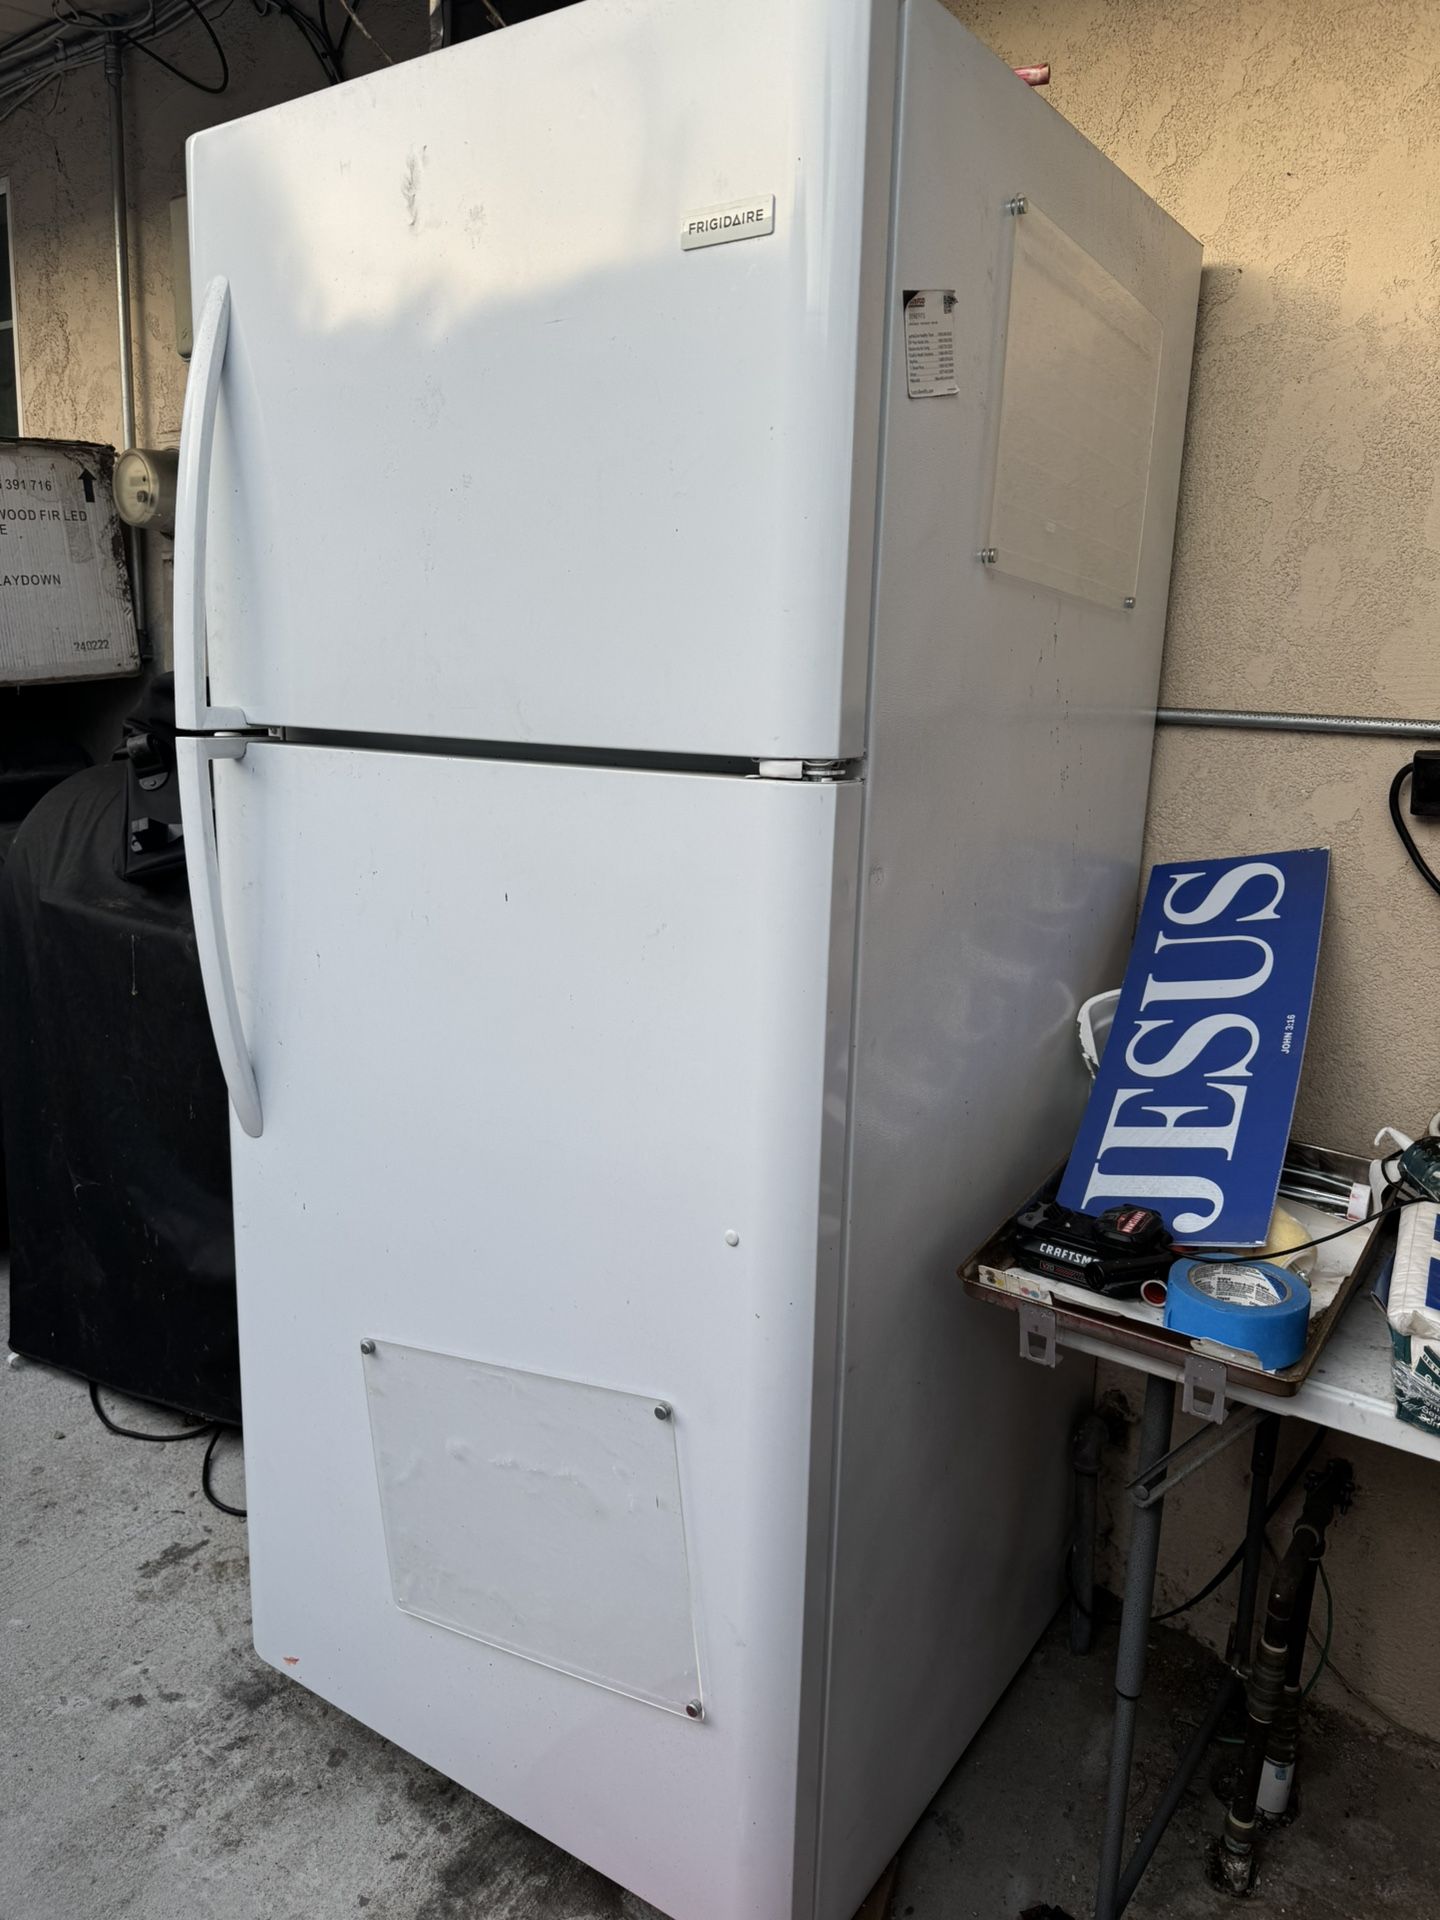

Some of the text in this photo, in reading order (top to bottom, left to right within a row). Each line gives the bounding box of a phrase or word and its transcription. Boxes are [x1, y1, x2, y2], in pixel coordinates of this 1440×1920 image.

[688, 208, 764, 235] FRIGIDAIRE
[5, 478, 52, 491] 391 716
[40, 509, 61, 521] FIR
[64, 510, 88, 522] LED
[0, 574, 61, 586] AYDOWN
[1281, 1014, 1296, 1055] JOHN 3:16
[1081, 862, 1286, 1235] JESUS
[1039, 1243, 1103, 1266] CRAFTSM
